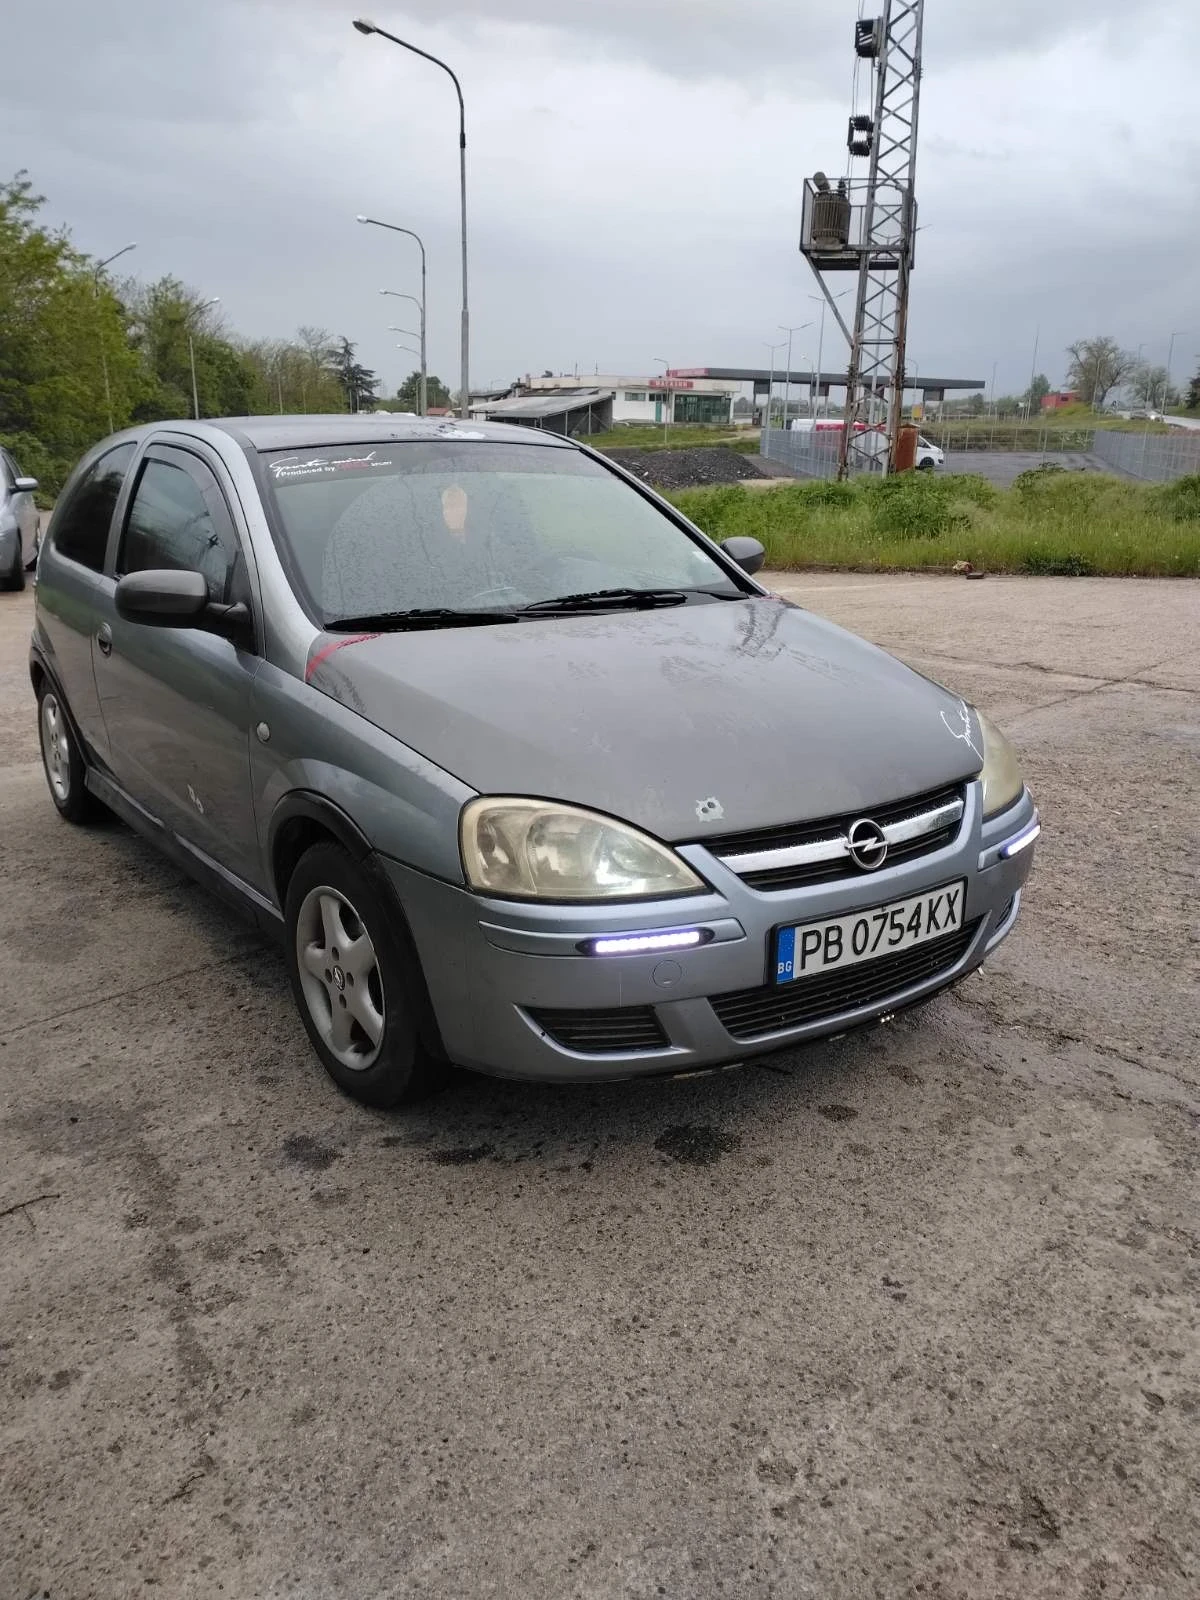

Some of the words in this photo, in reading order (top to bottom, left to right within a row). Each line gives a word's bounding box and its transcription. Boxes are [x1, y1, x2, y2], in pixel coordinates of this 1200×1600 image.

[801, 925, 843, 970] PB
[852, 902, 922, 956] 0754
[926, 889, 959, 933] KX
[777, 960, 792, 974] BG
